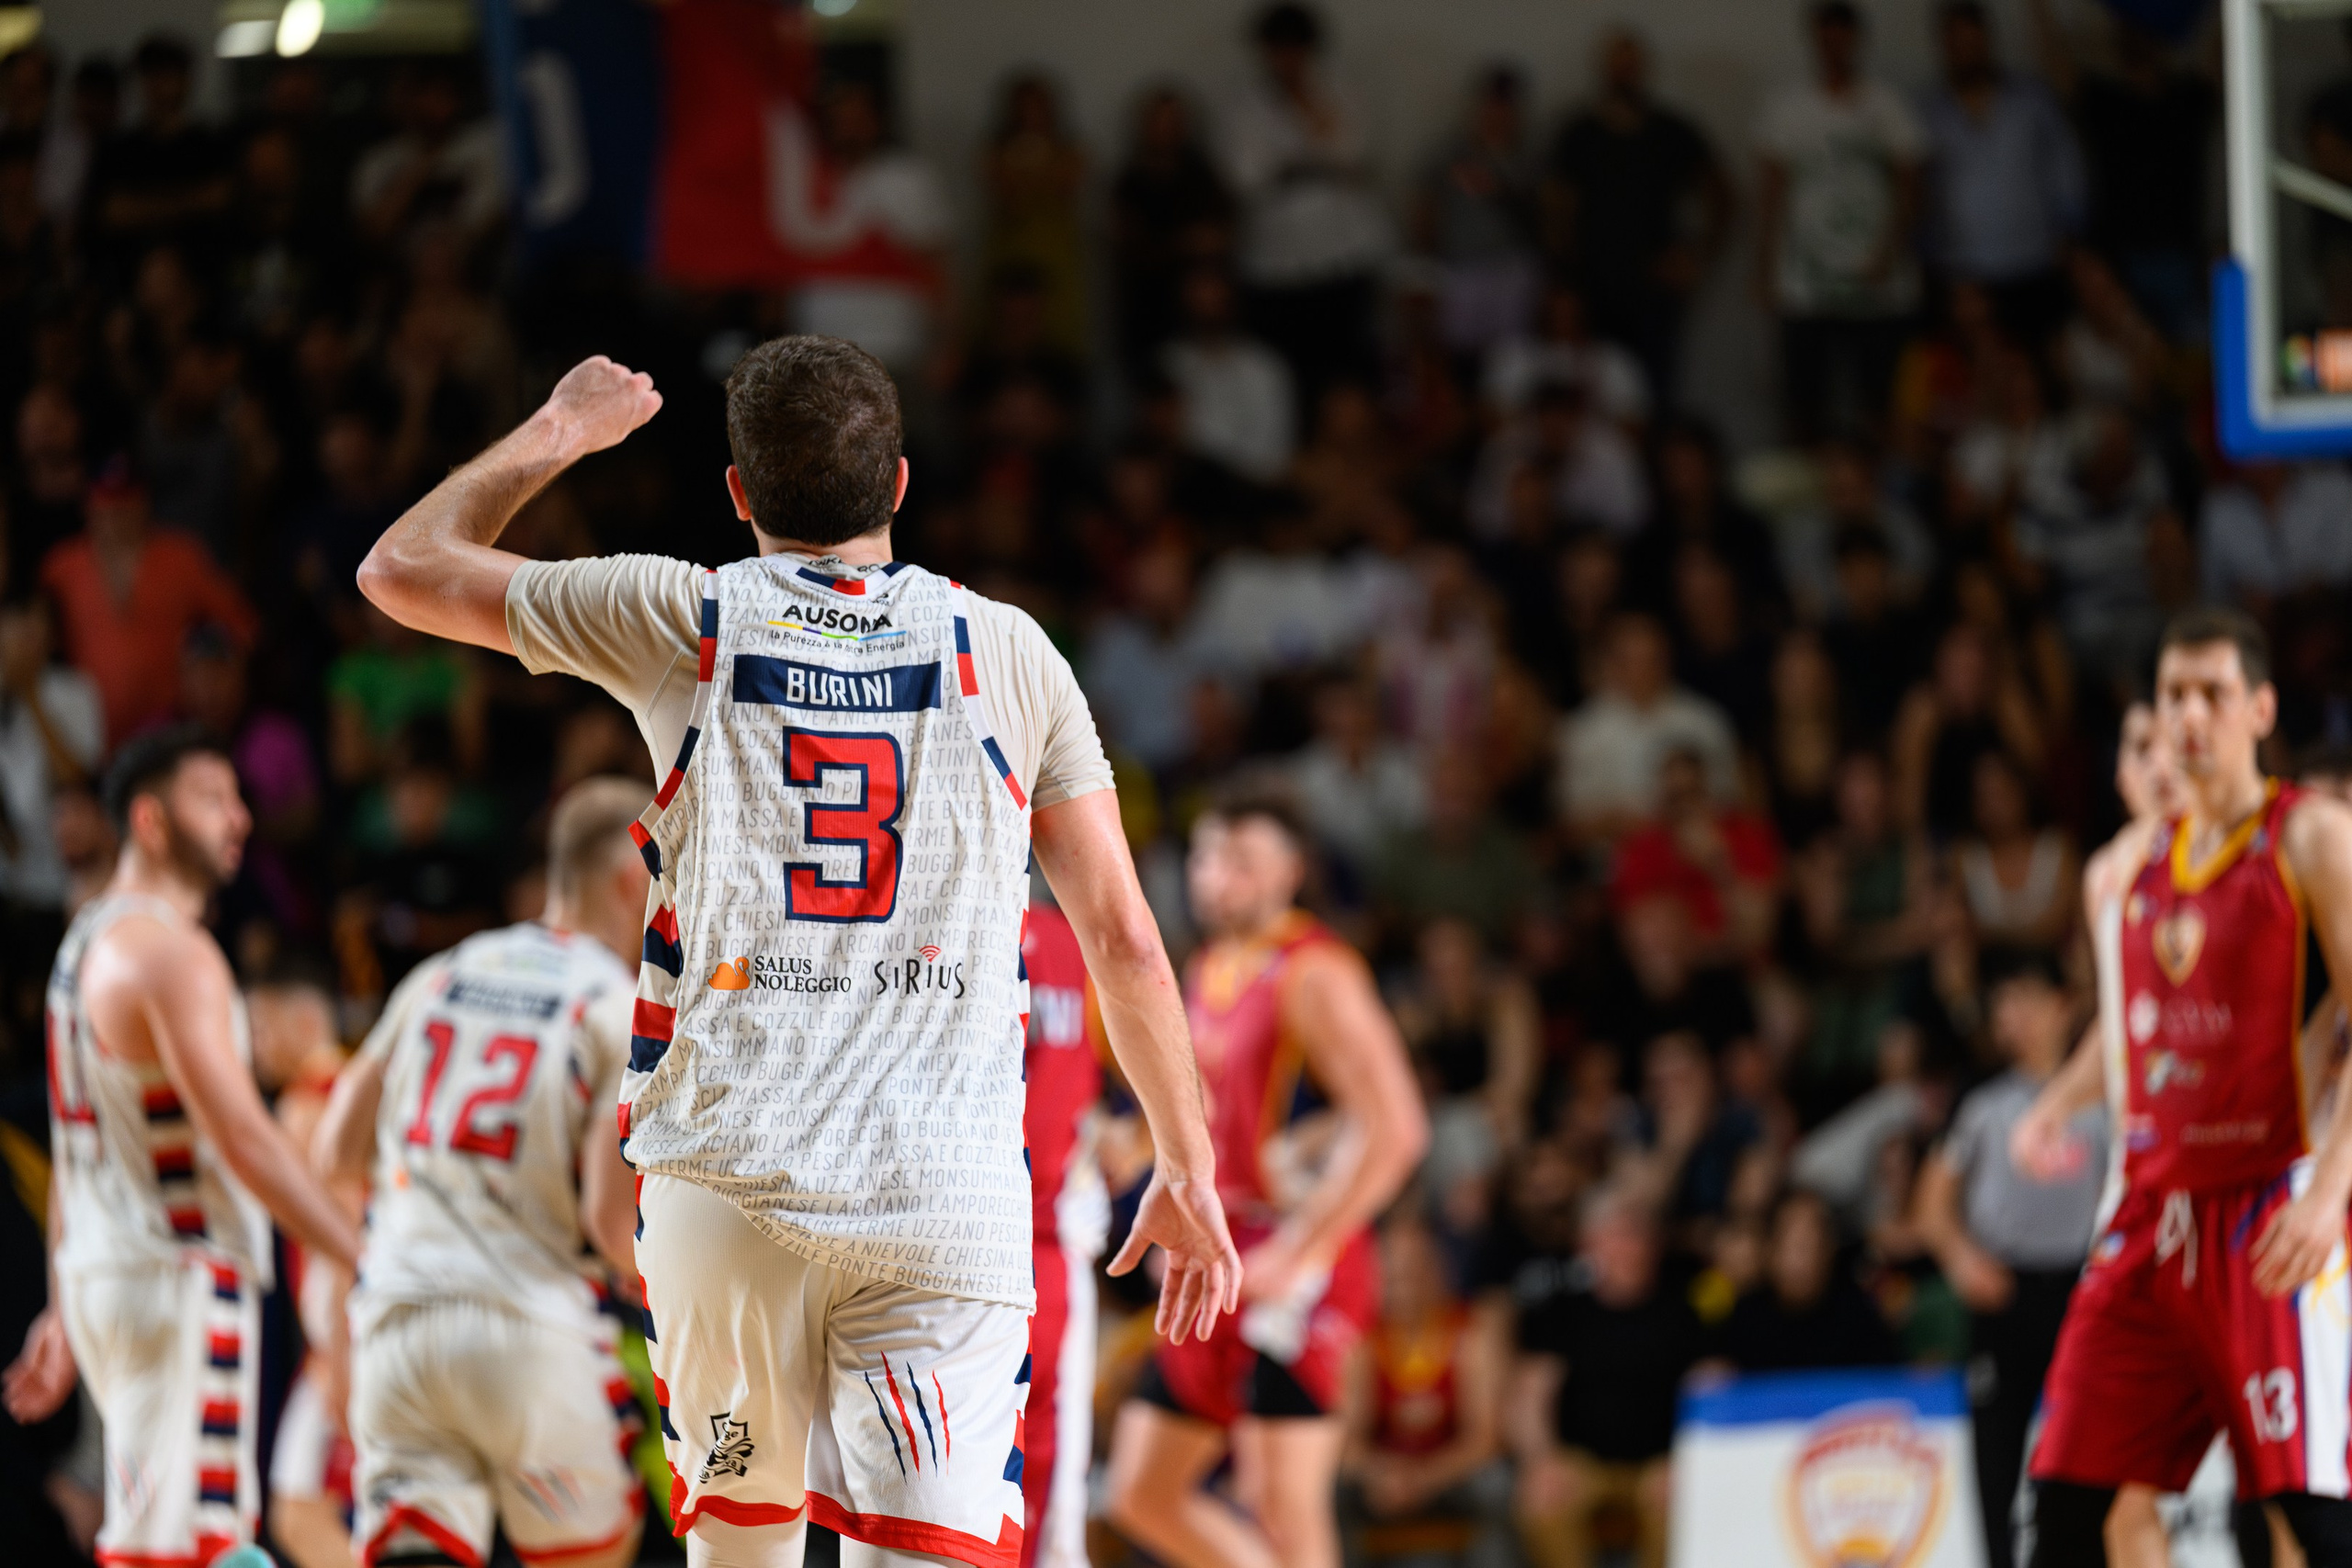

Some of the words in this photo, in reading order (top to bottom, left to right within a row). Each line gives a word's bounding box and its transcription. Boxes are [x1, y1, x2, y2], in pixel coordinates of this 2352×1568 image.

[786, 667, 892, 707] BURINI
[720, 807, 783, 829] MASSA
[783, 726, 904, 924] 3
[705, 935, 815, 961] BUGGIANESE
[822, 931, 906, 956] LARCIANO
[754, 954, 812, 975] SALUS
[753, 974, 852, 993] NOLEGGIO
[752, 1011, 827, 1032] COZZILE
[831, 1006, 886, 1031] PONTE
[677, 1035, 806, 1063] MONSUMMANO
[811, 1030, 862, 1055] TERME
[757, 1056, 845, 1081] BUGGIANO
[850, 1055, 896, 1076] PIEVE
[406, 1021, 538, 1162] 12
[731, 1085, 795, 1106] MASSA
[814, 1078, 879, 1102] COZZILE
[888, 1077, 944, 1096] PONTE
[770, 1100, 896, 1128] MONSUMMANO
[901, 1099, 956, 1118] TERME
[677, 1133, 768, 1155] LARCIANO
[772, 1121, 910, 1154] LAMPORECCHIO
[919, 1120, 998, 1141] BUGGIANO
[718, 1155, 794, 1178] UZZANO
[801, 1148, 864, 1170] PESCIA
[869, 1144, 933, 1168] MASSA
[816, 1169, 911, 1194] UZZANESE
[825, 1195, 921, 1217] LARCIANO
[845, 1217, 907, 1237] TERME
[911, 1218, 985, 1241] UZZANO
[861, 1240, 940, 1265] NIEVOLE
[944, 1245, 1014, 1269] CHIESINA
[827, 1253, 888, 1280] PONTE
[894, 1262, 1003, 1294] BUGGIANESE
[2242, 1366, 2300, 1445] 13
